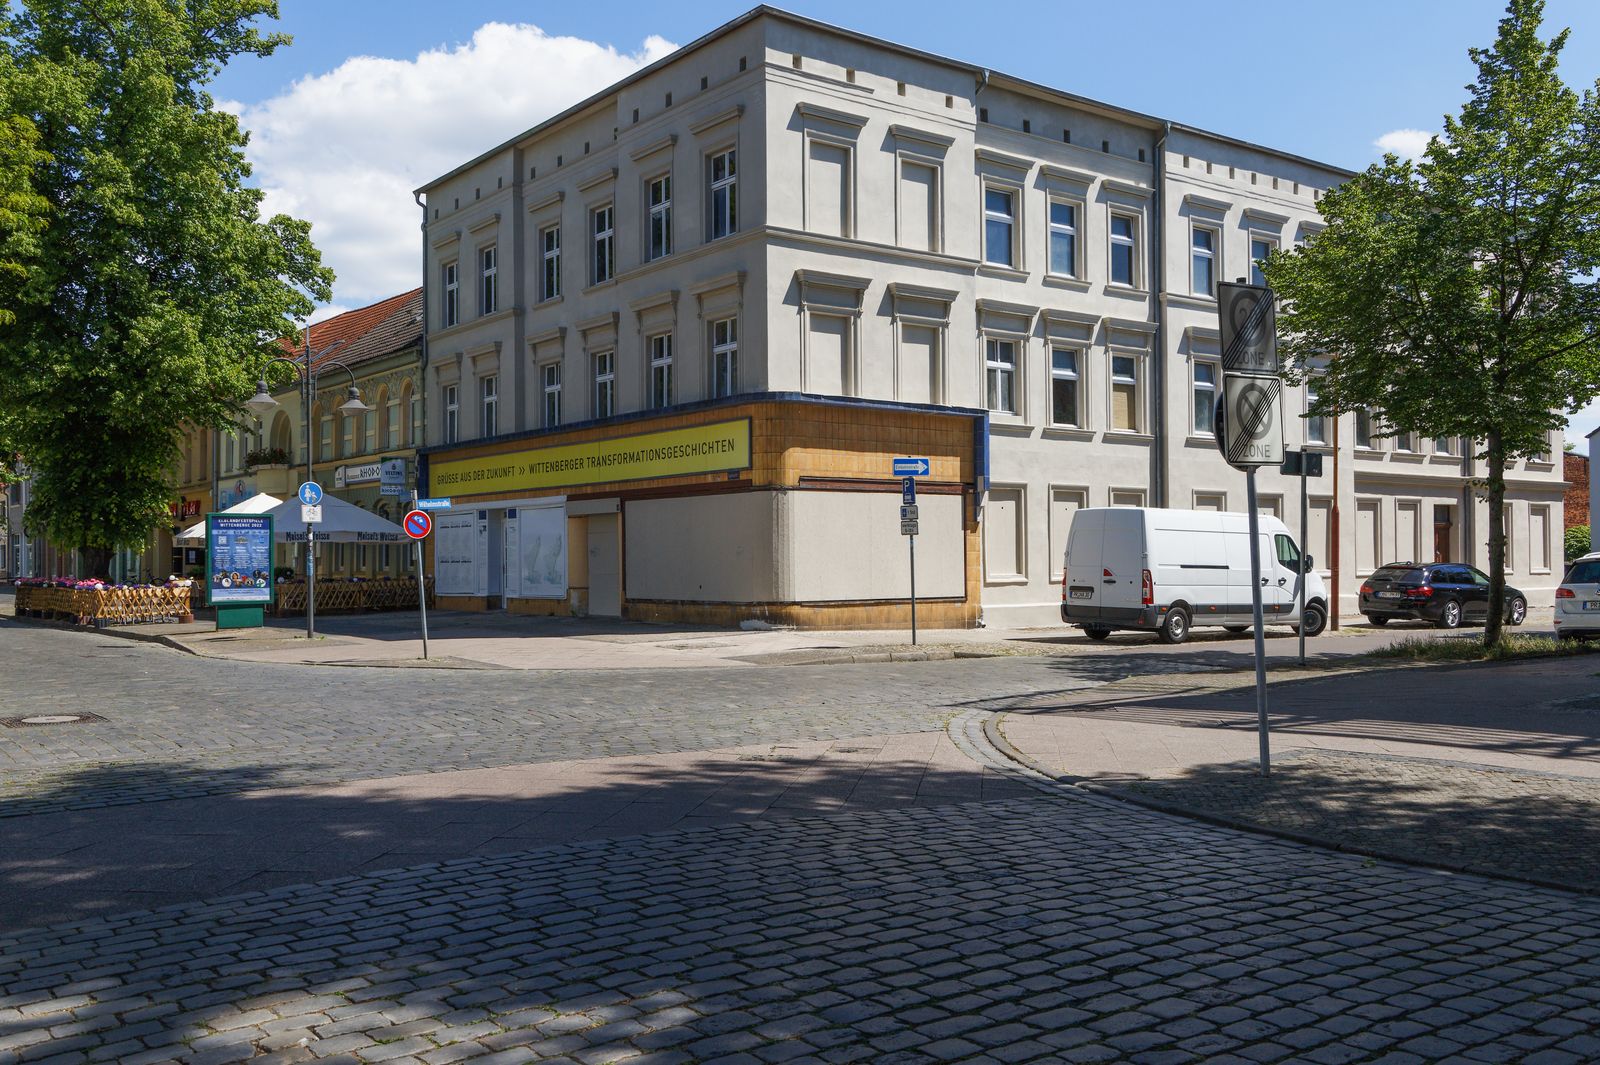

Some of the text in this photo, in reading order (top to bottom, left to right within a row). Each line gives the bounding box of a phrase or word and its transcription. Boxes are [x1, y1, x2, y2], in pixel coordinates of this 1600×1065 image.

[1243, 444, 1271, 458] ZONE
[437, 439, 735, 485] GRÜSSE AUS DER ZUKUNFT WITTENBERGER TRANSFORMATIONSGESCHICHTEN
[359, 466, 382, 479] RHODO
[904, 480, 910, 492] P
[357, 531, 398, 541] Meisel's Weisse
